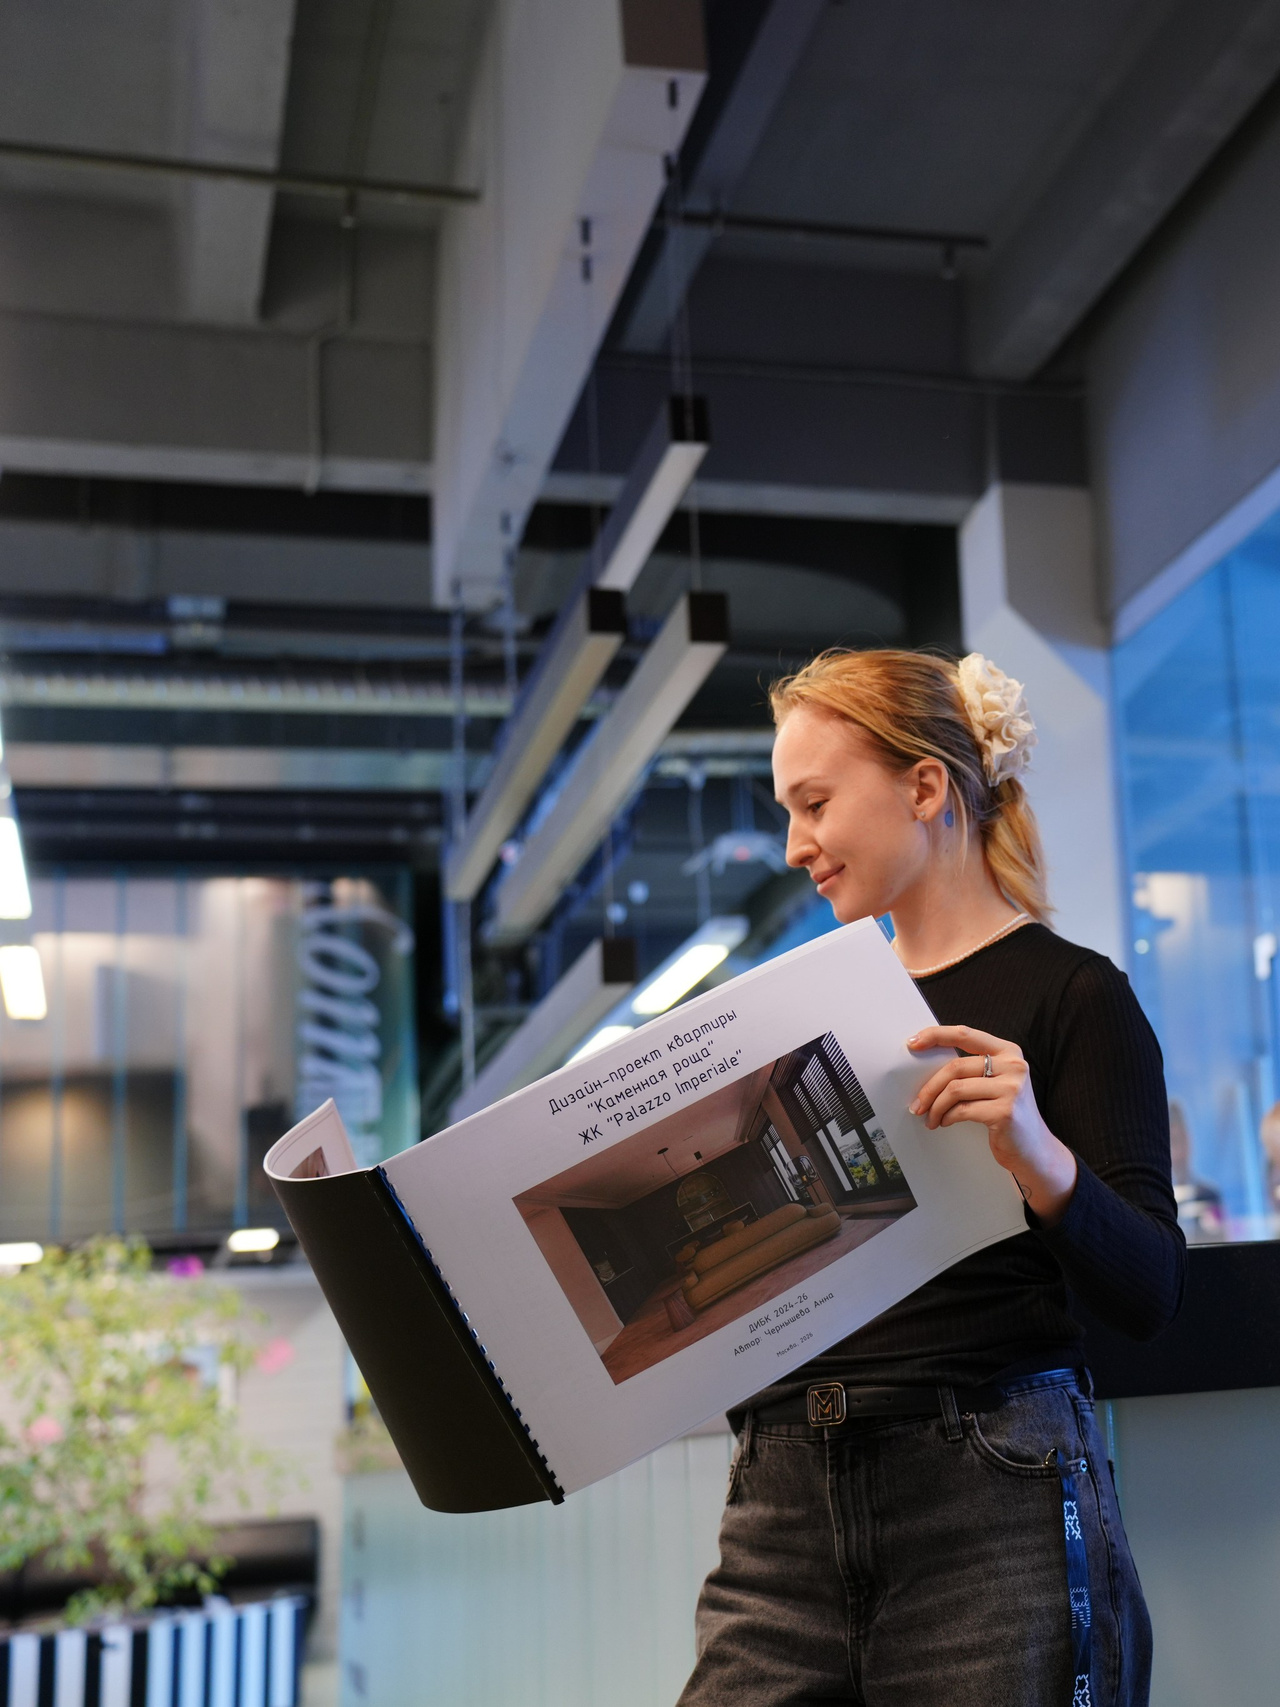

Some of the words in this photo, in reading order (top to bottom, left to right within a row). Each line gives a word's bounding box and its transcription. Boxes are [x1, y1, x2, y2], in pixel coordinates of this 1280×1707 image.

[548, 1048, 663, 1116] Дизайн-проект
[666, 1008, 738, 1053] квартиры
[578, 1123, 604, 1146] ЖК
[606, 1091, 672, 1127] "Palazzo
[675, 1049, 742, 1096] Imperiale"
[587, 1069, 668, 1114] "Каменная
[672, 1039, 715, 1076] роща"
[733, 1335, 763, 1357] Автор:
[764, 1306, 811, 1337] Чернышева
[813, 1292, 835, 1309] Анна
[748, 1314, 772, 1334] ДИБК
[773, 1292, 809, 1318] 2024-26
